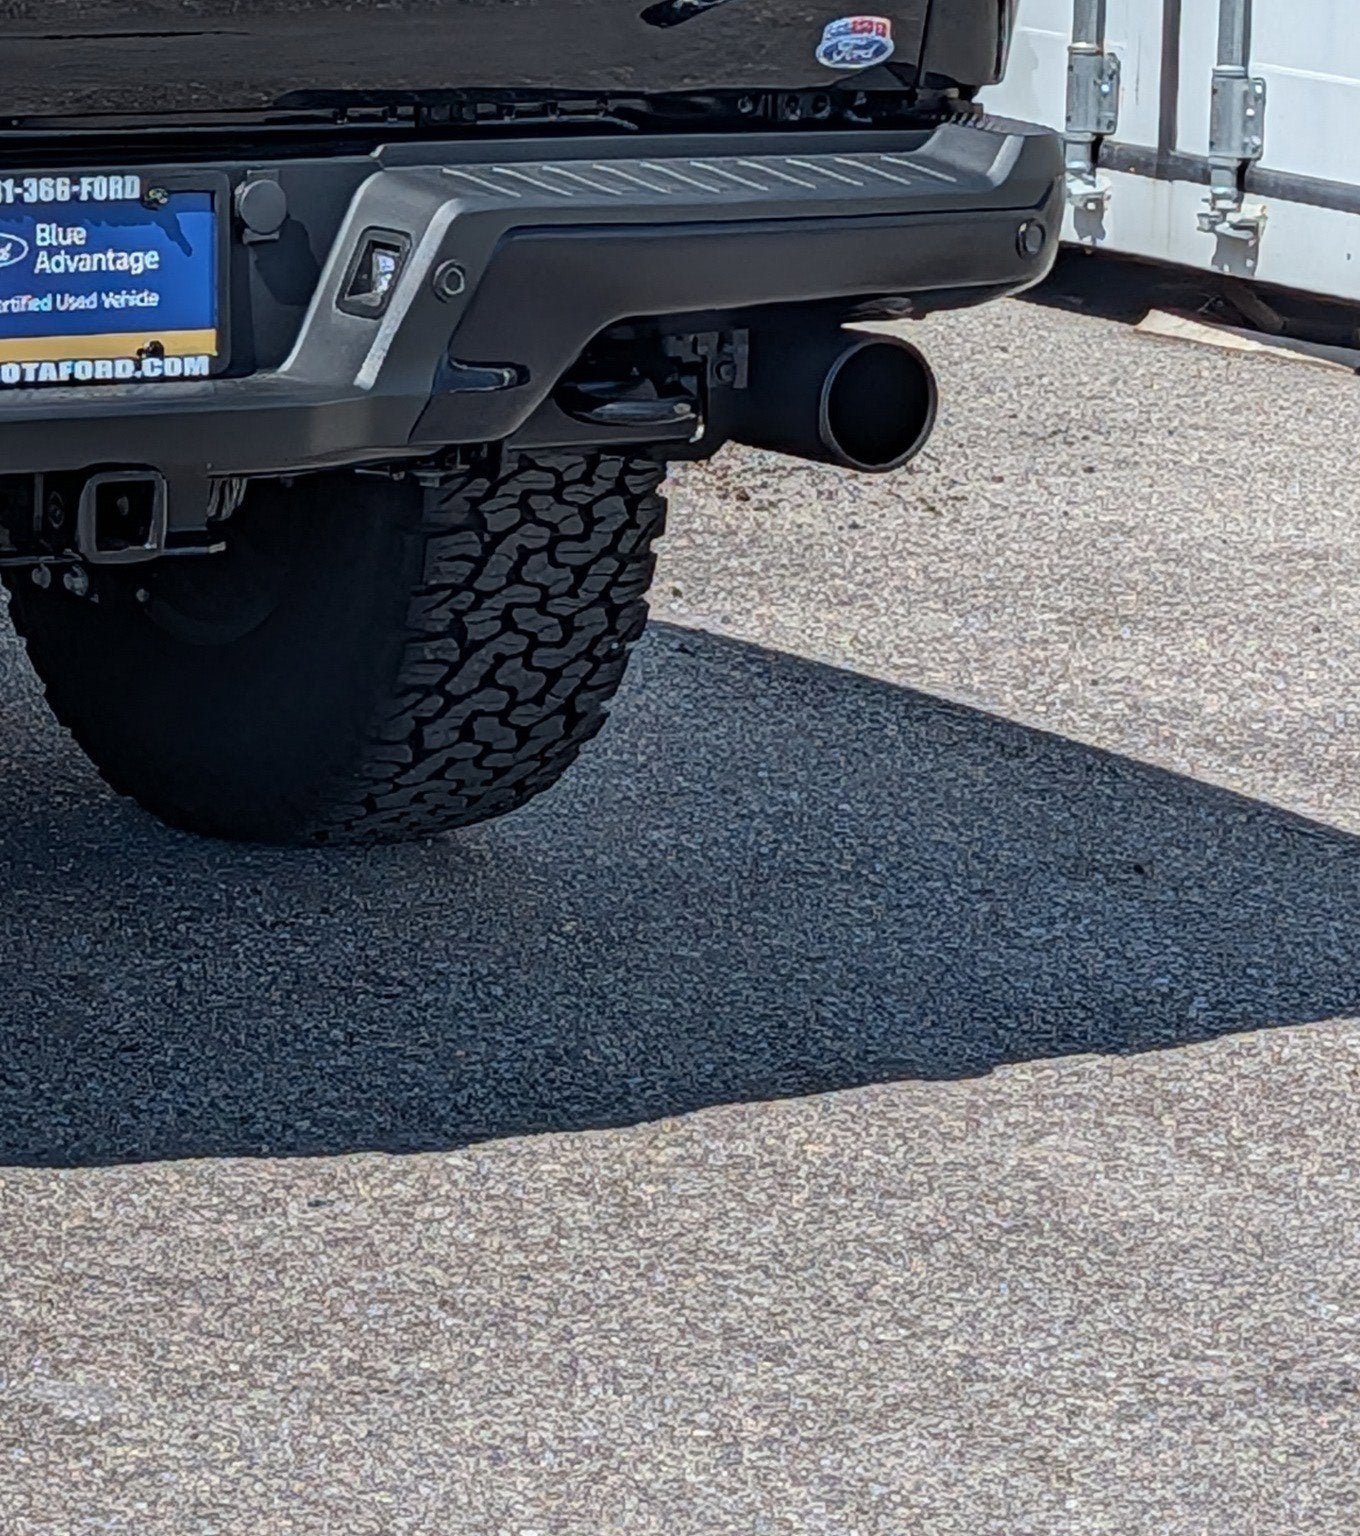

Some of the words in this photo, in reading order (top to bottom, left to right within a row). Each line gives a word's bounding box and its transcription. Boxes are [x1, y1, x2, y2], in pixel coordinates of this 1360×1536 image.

[35, 223, 86, 247] Blue
[33, 248, 160, 275] Advantage
[55, 291, 97, 311] Used
[101, 289, 160, 309] Vehicle
